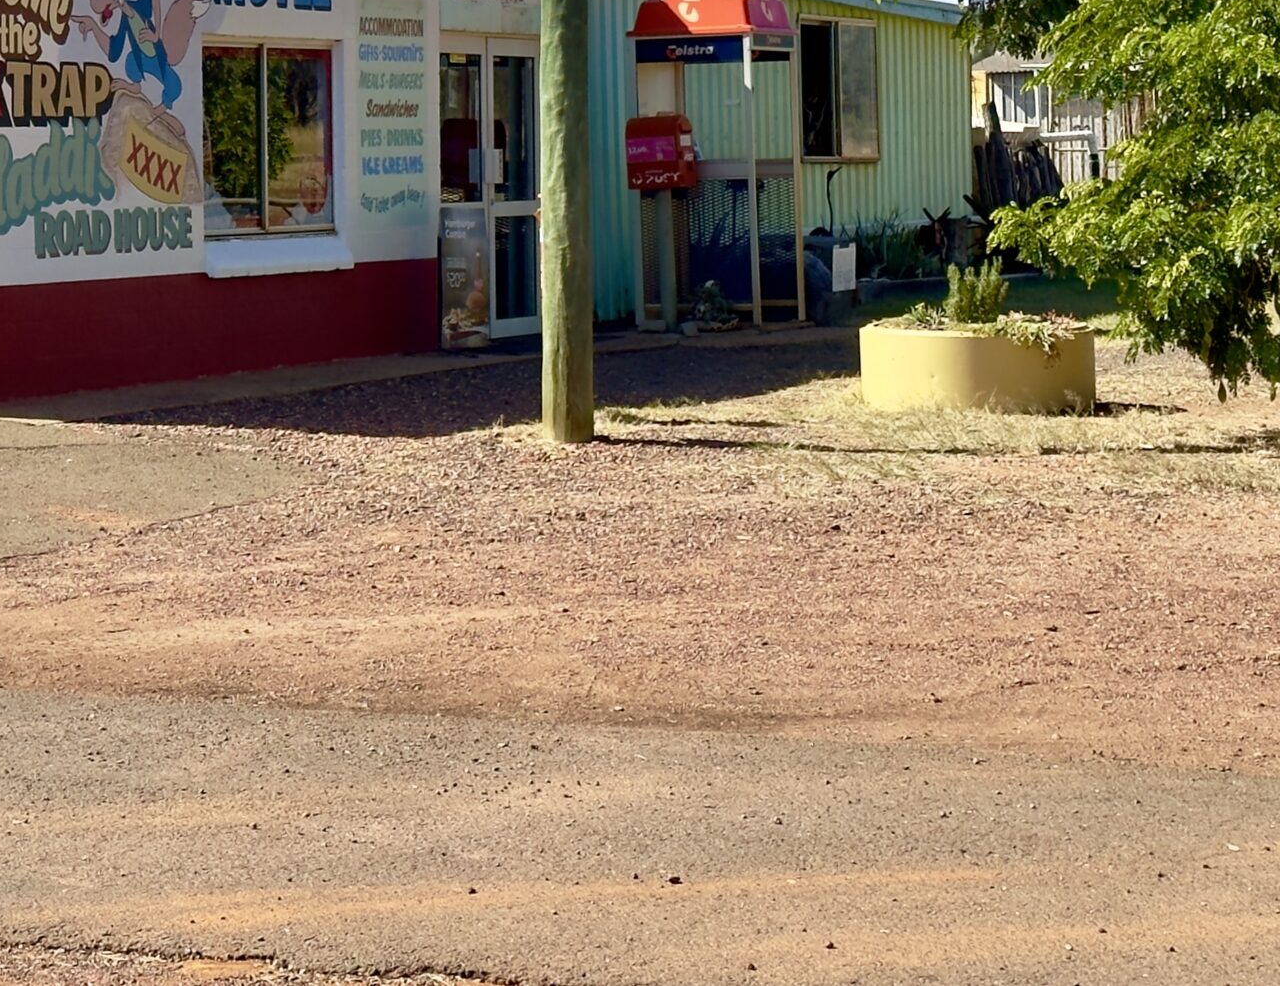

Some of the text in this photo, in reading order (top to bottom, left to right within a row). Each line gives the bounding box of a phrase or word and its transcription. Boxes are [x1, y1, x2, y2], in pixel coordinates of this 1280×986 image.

[359, 16, 424, 37] ACCOMMODATION
[667, 45, 715, 60] Telstra
[5, 62, 112, 126] TRAP
[365, 98, 419, 118] Sandwiches
[360, 128, 424, 148] PIES DRINKS
[126, 133, 183, 196] XXXX
[361, 154, 424, 176] ICE CREAMS
[34, 206, 193, 259] ROAD HOUSE
